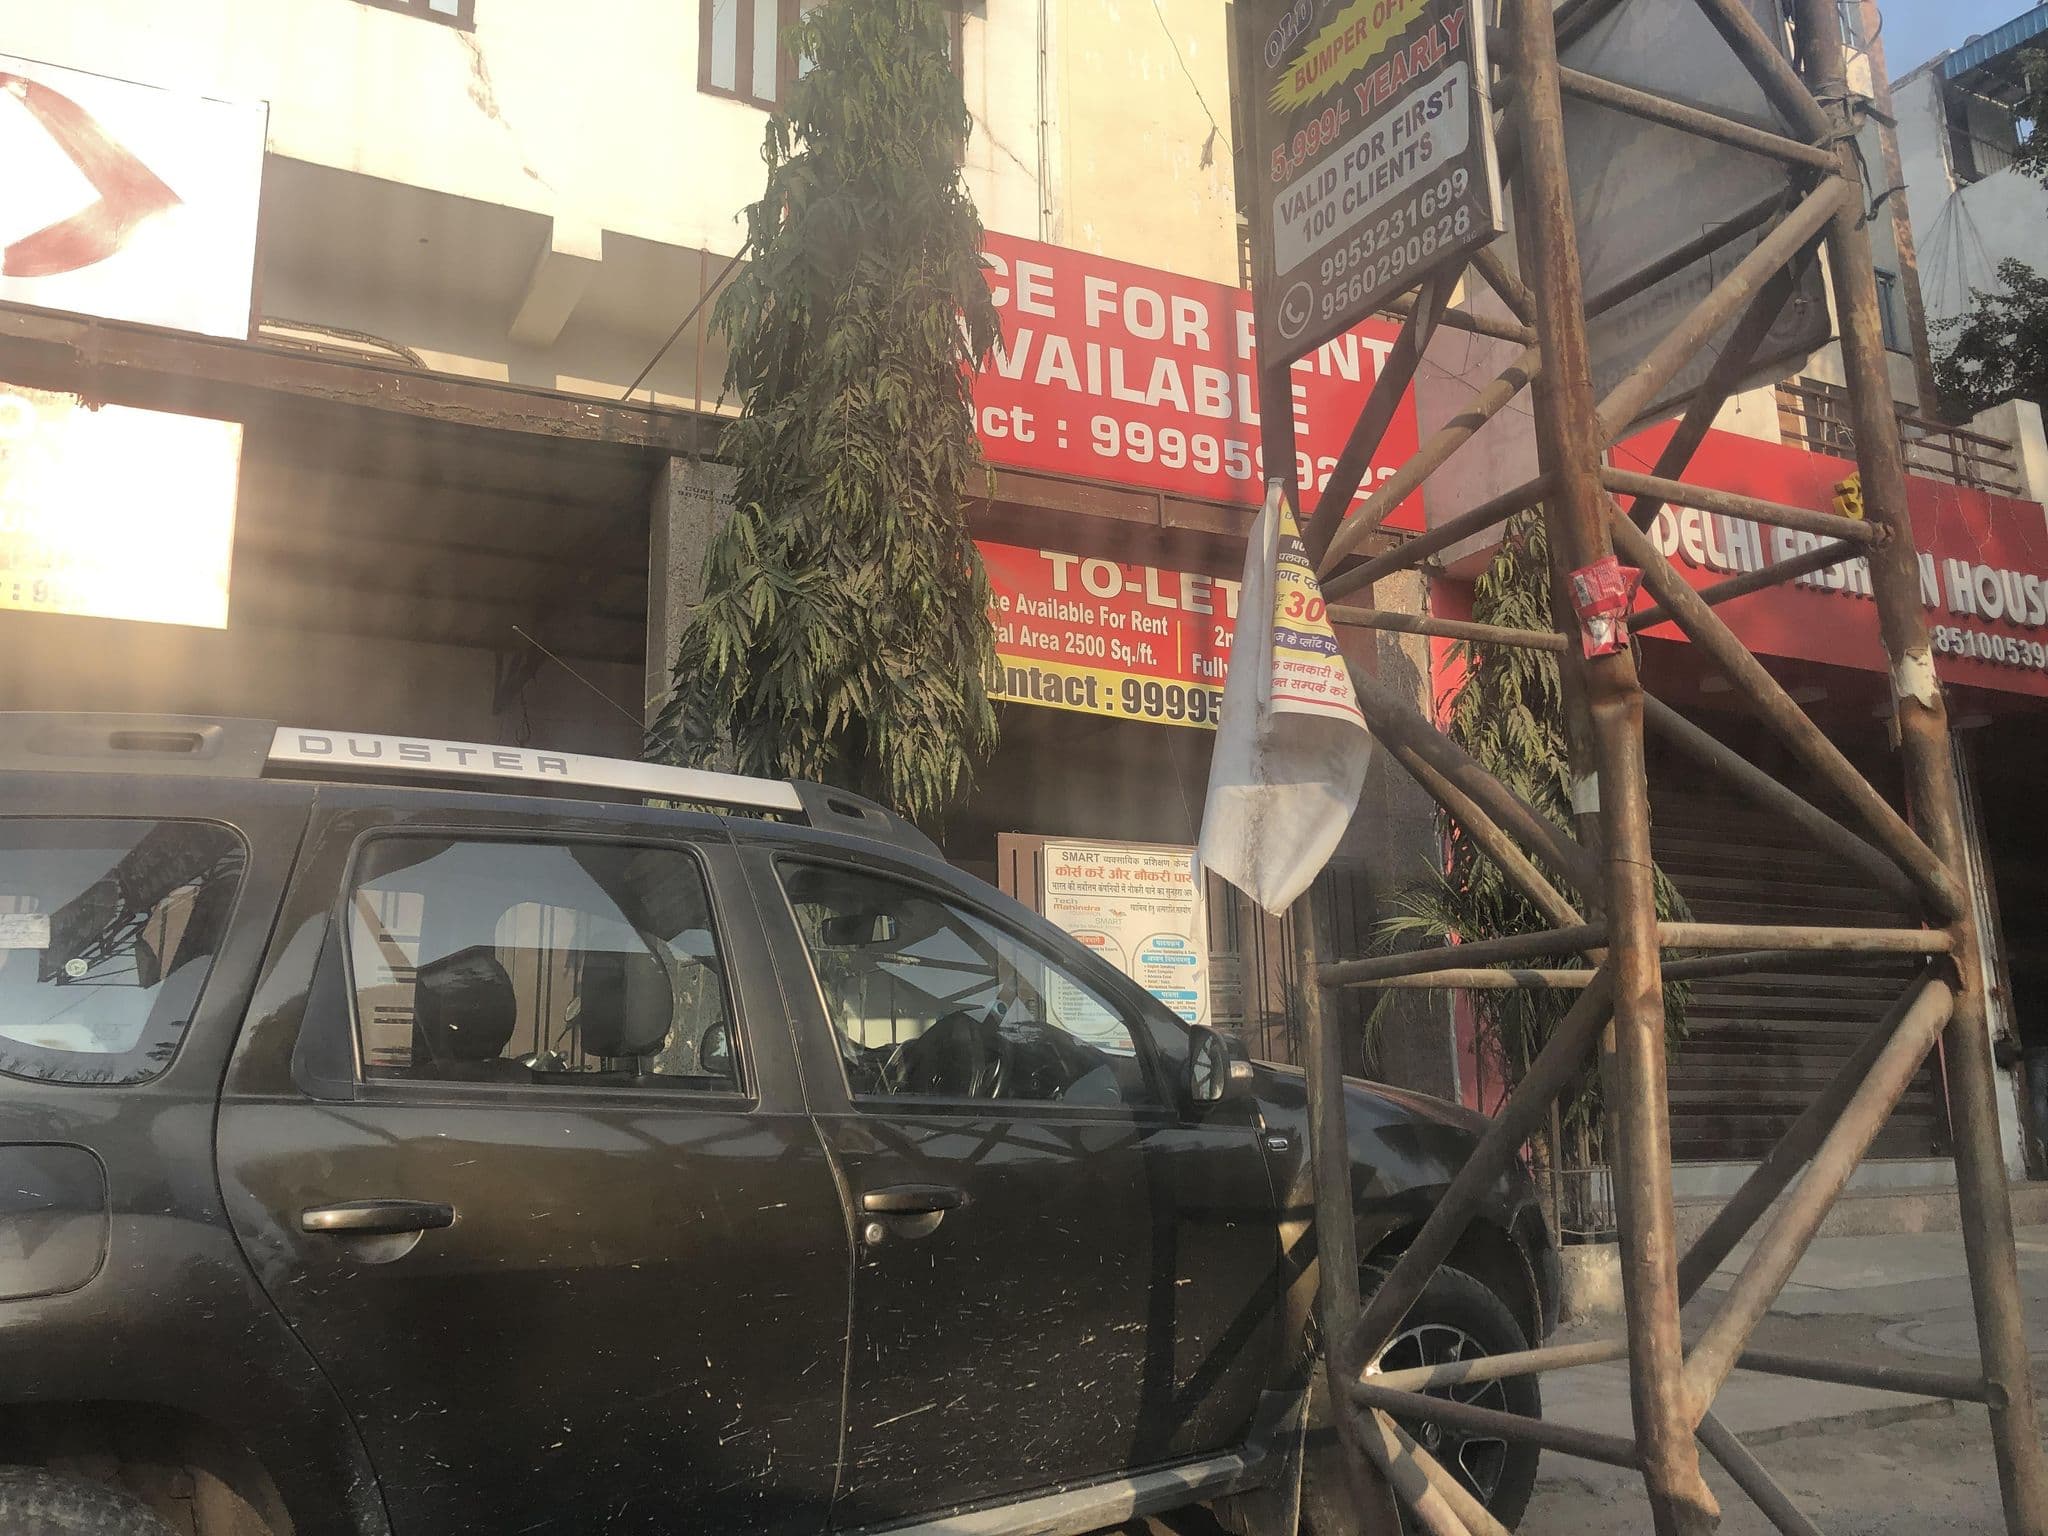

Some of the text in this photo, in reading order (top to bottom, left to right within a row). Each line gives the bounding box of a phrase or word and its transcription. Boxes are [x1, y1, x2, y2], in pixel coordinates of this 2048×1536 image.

[1295, 16, 1368, 94] BUMPER
[1271, 7, 1466, 182] 5,999/- YEARLY
[1280, 77, 1458, 226] VALID FOR FIRST
[1303, 132, 1433, 244] 100 CLIENTS
[1320, 168, 1469, 287] 9953231699
[1321, 204, 1470, 320] 9560290828
[1084, 275, 1211, 351] FOR
[1040, 549, 1241, 620] TO-LET
[1649, 500, 1764, 572] DELHI
[1943, 558, 2048, 627] HOUS
[1015, 592, 1095, 626] Available
[1100, 603, 1127, 630] For
[1131, 610, 1169, 636] Rent
[1020, 624, 1060, 652] Area
[1065, 631, 1107, 659] 2500
[1111, 639, 1158, 668] Sq./ft.
[1283, 661, 1332, 679] जानकारी
[1324, 640, 1337, 653] पर
[1932, 624, 2048, 671] 85100539
[1291, 679, 1327, 694] सम्पर्क
[299, 734, 570, 775] DUSTER
[1055, 864, 1081, 878] कोर्स
[1108, 868, 1131, 881] और
[1062, 851, 1100, 863] SMART
